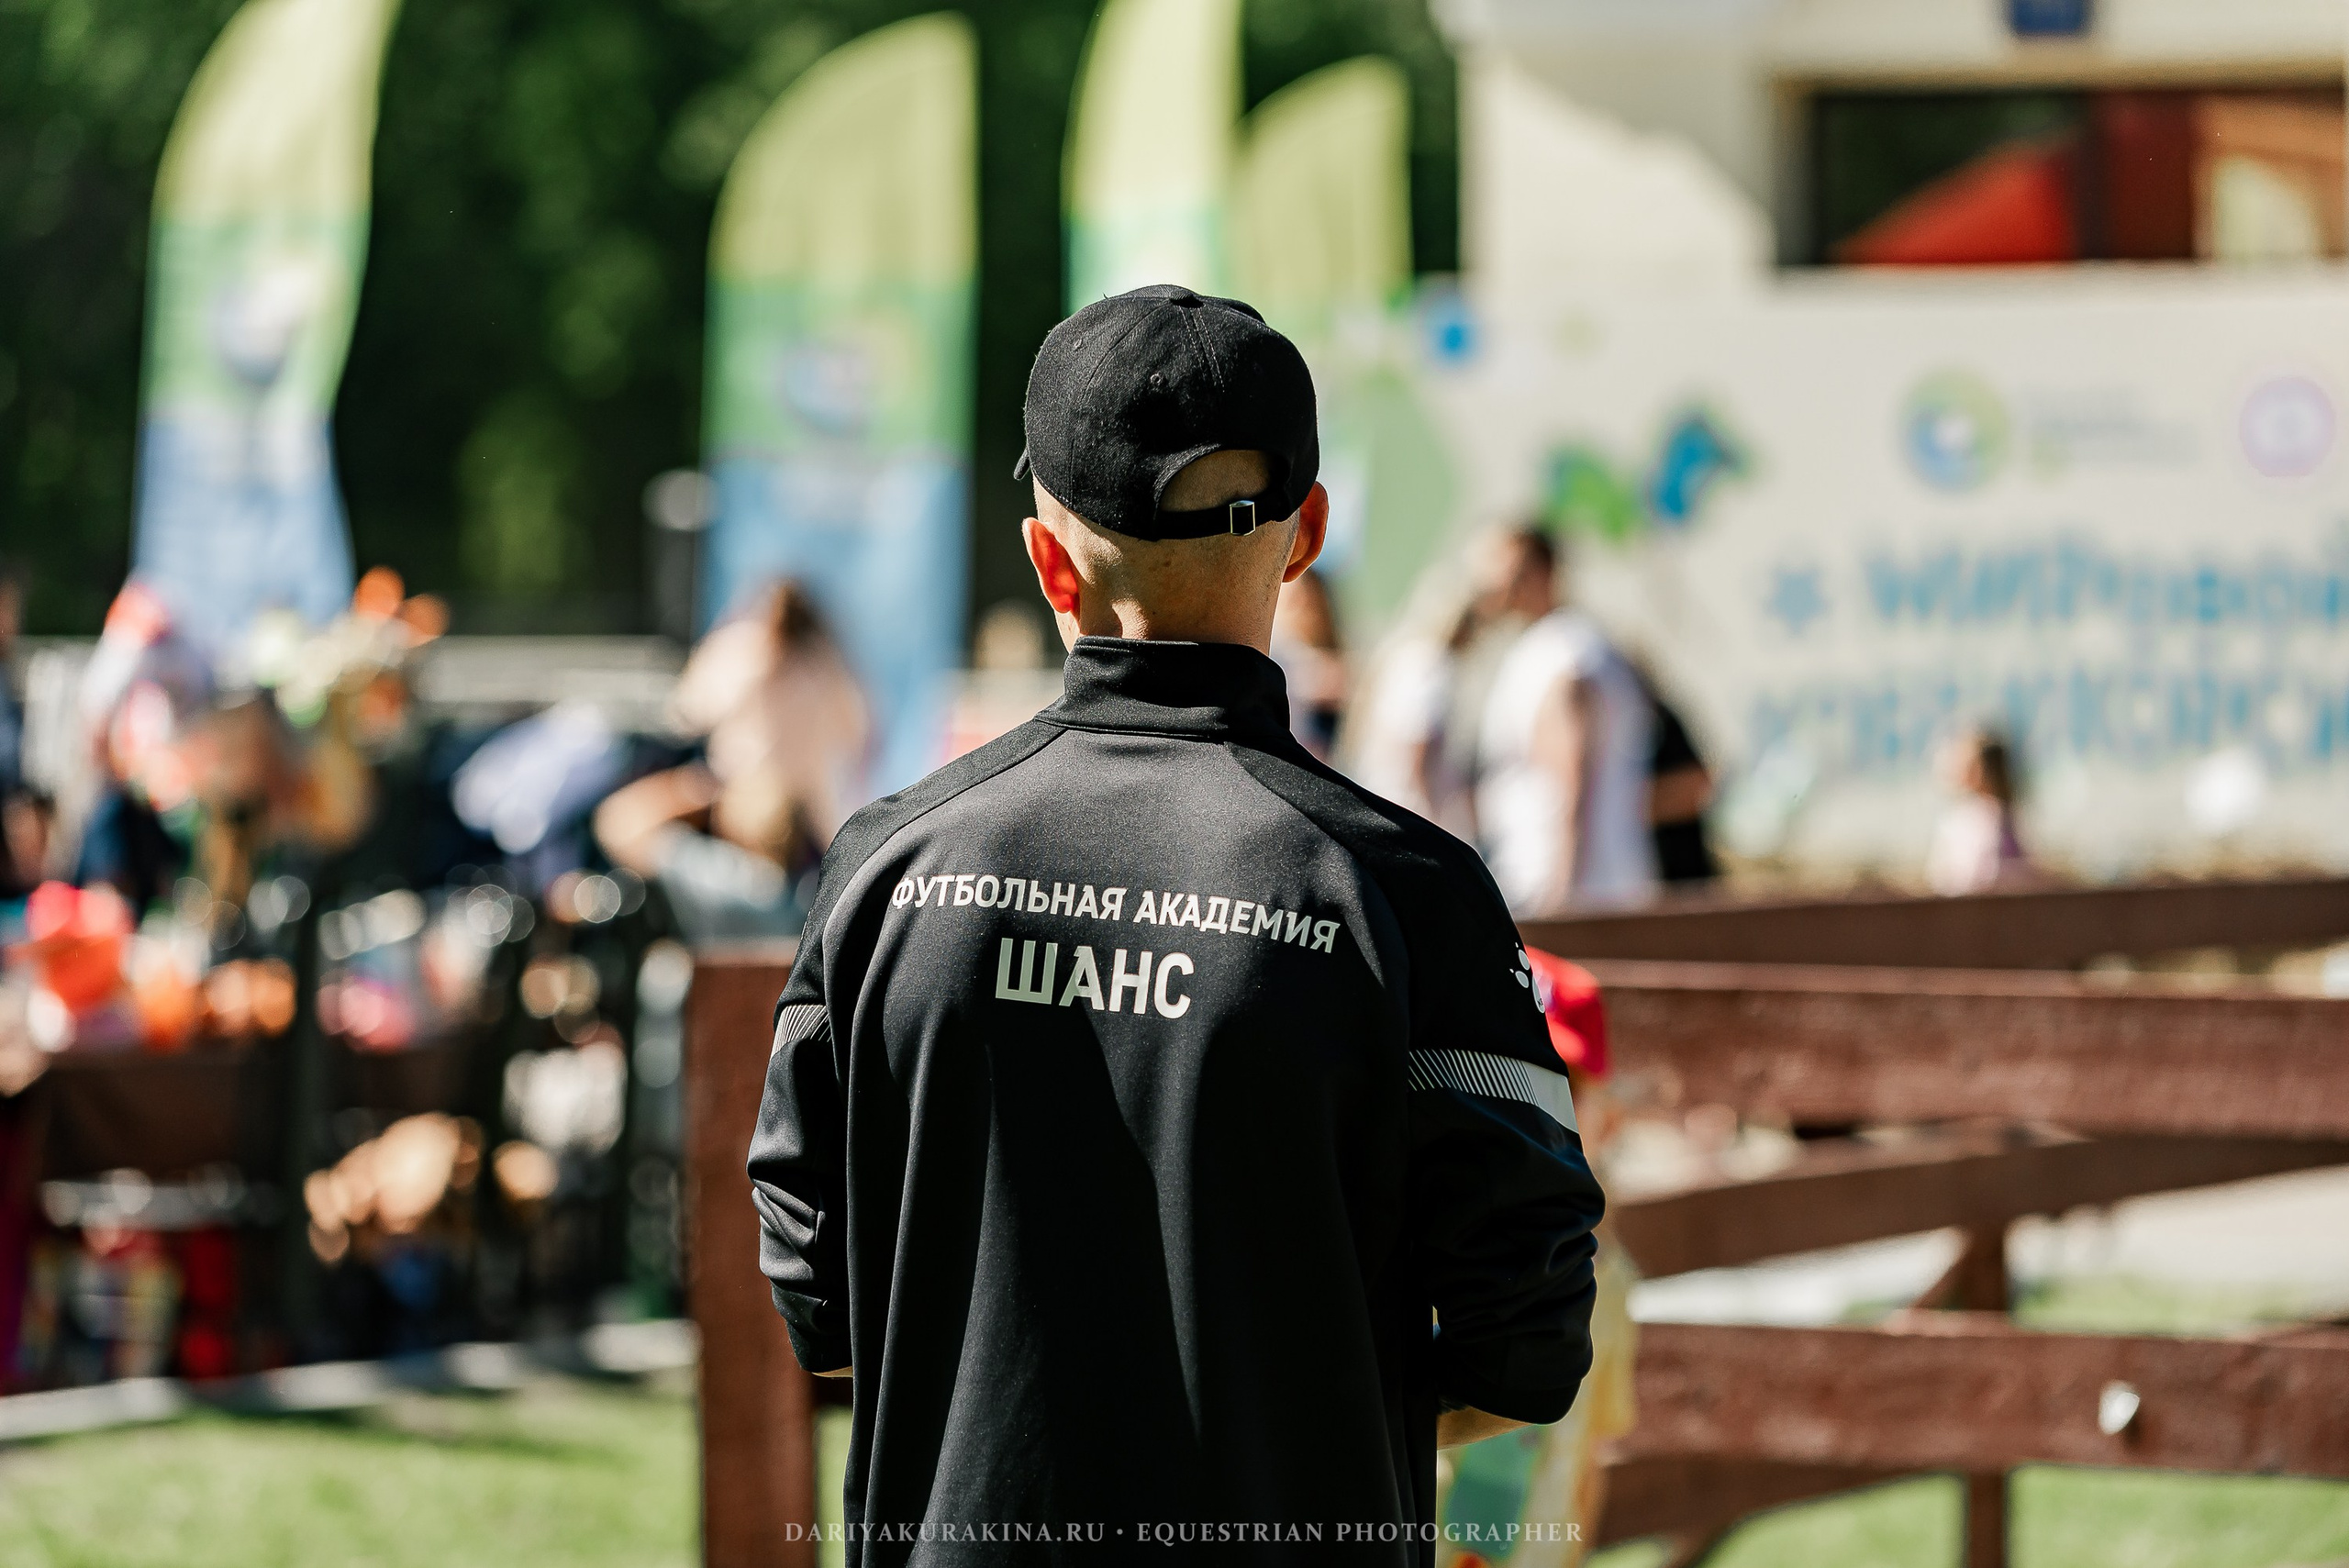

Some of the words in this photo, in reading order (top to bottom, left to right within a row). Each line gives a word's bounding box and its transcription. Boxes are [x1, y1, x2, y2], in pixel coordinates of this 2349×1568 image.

[892, 873, 1128, 921] ФУТБОЛЬНАЯ
[1132, 889, 1341, 954] АКАДЕМИЯ
[995, 937, 1195, 1019] ШАНС
